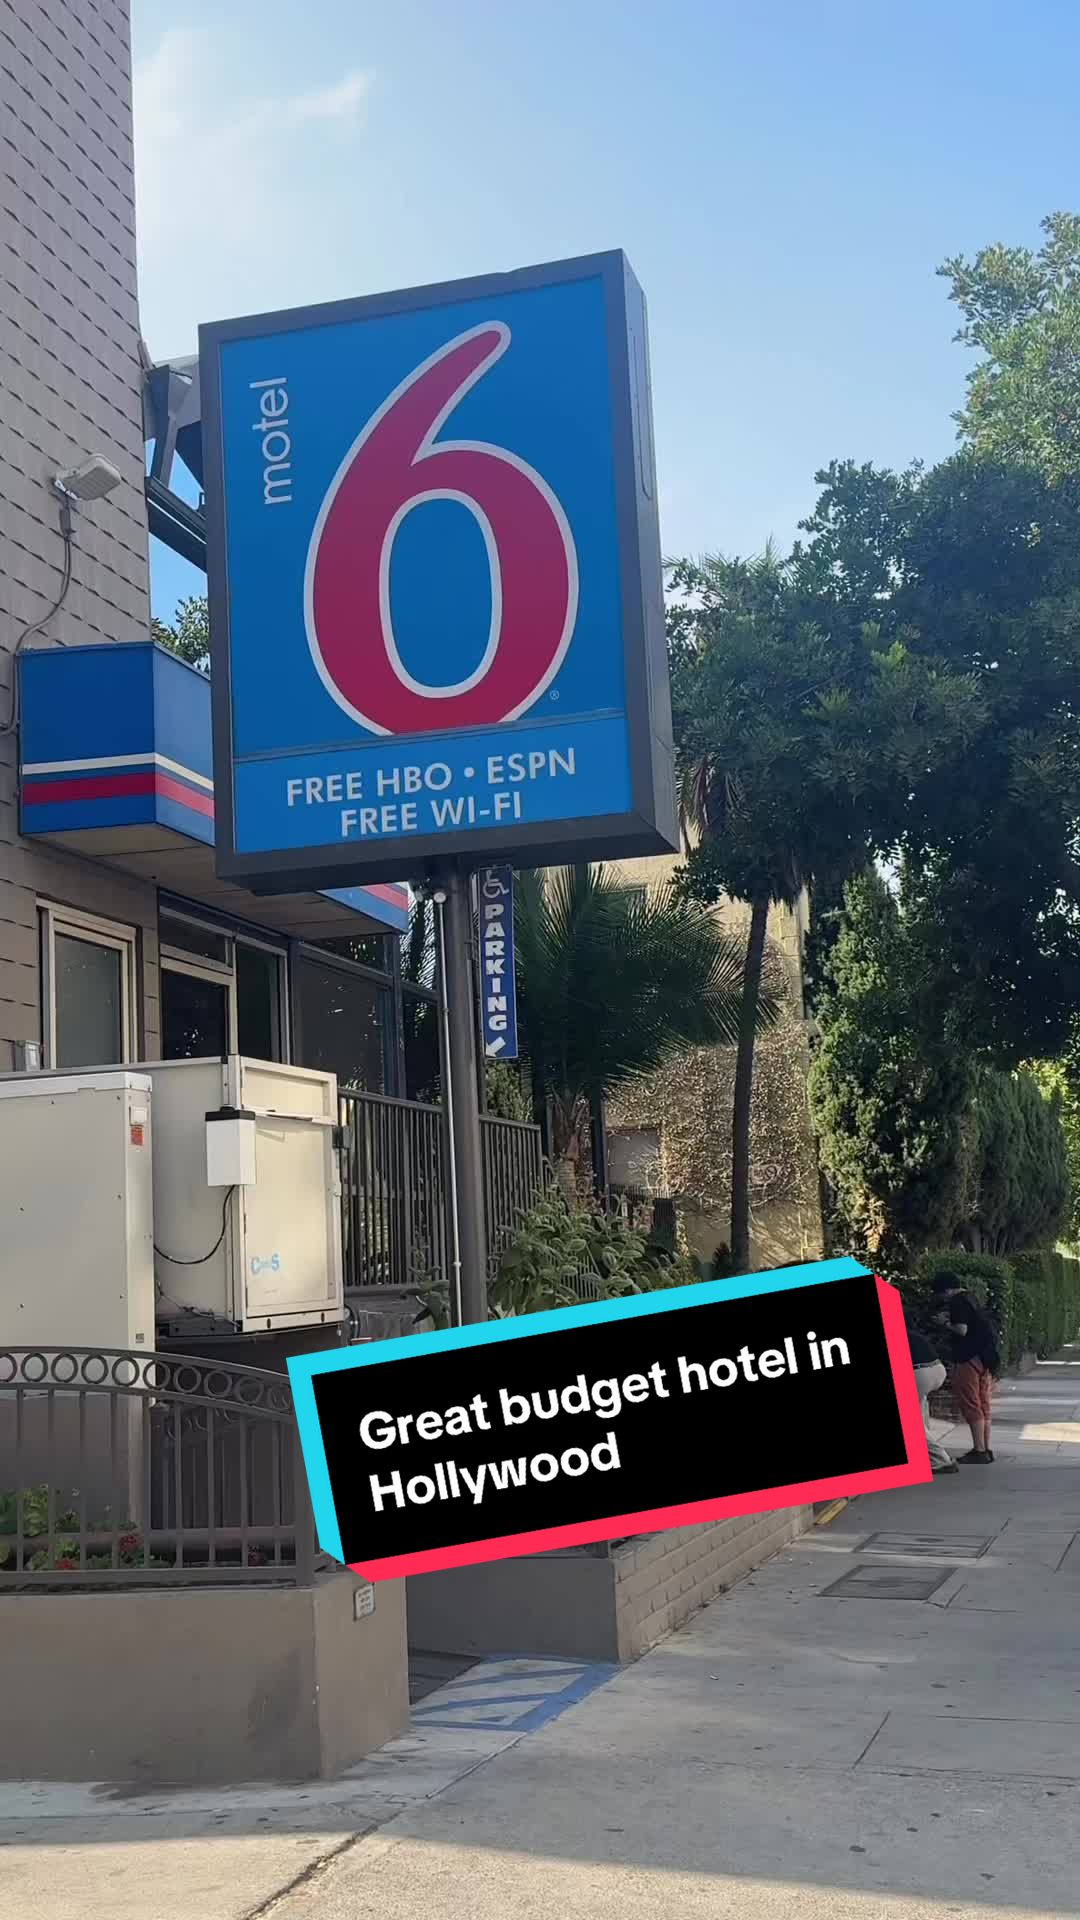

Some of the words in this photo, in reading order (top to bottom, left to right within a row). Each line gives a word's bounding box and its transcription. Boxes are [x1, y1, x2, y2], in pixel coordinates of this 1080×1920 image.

[249, 376, 293, 506] motel
[303, 319, 580, 737] 6
[286, 771, 363, 807] FREE
[376, 762, 452, 797] HBO
[486, 747, 576, 785] ESPN
[340, 802, 418, 838] FREE
[430, 790, 522, 828] WI-FI
[484, 903, 508, 1032] PARKING
